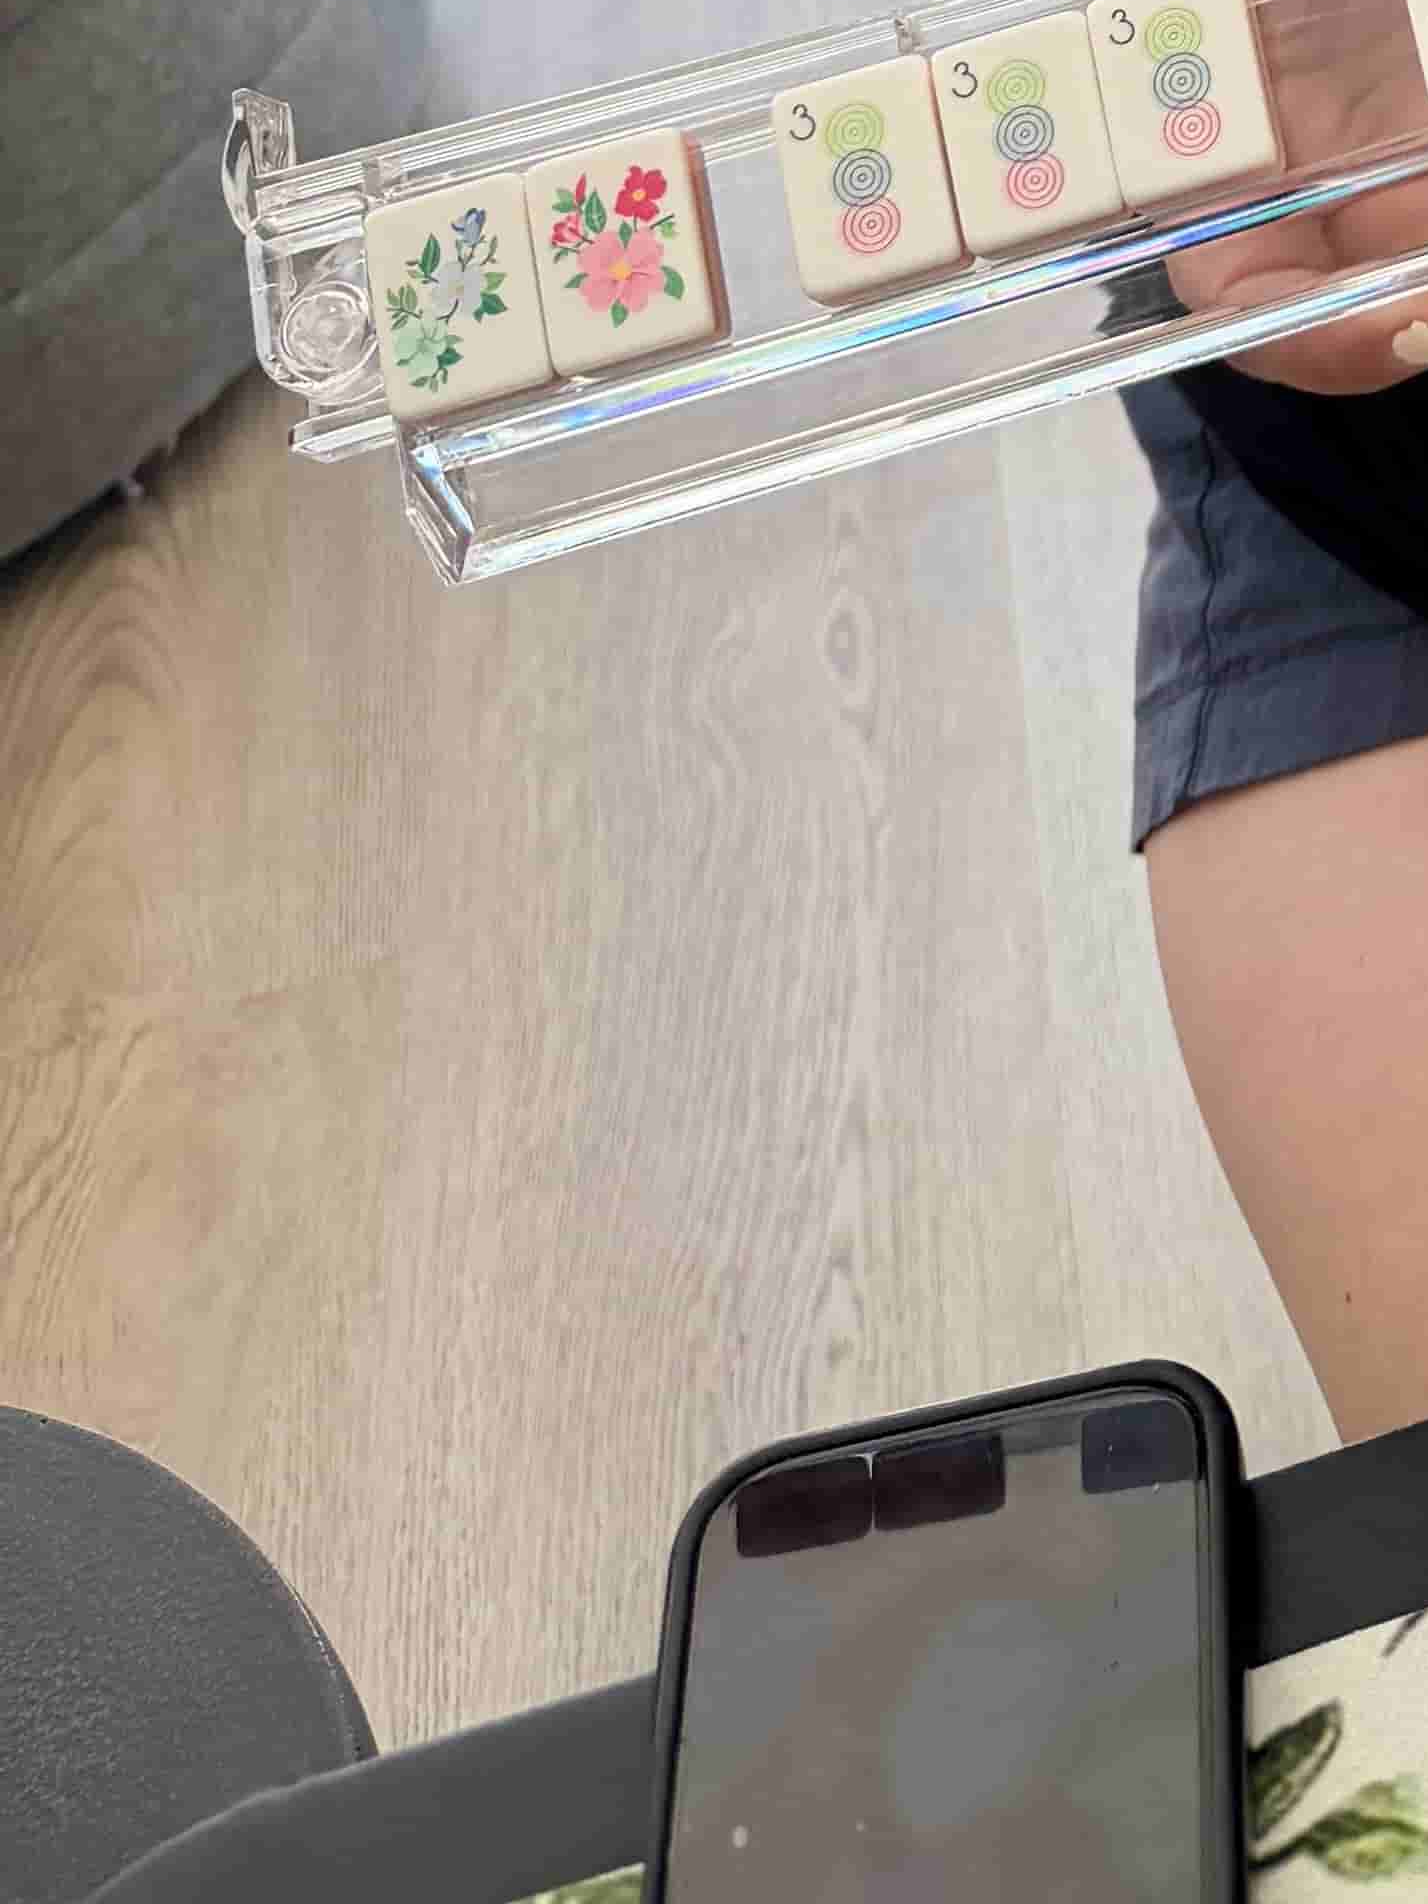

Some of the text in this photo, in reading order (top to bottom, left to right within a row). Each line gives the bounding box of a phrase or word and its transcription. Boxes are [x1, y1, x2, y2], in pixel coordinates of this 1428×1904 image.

[1108, 8, 1136, 46] 3
[951, 60, 979, 99] 3
[789, 103, 817, 142] 3
